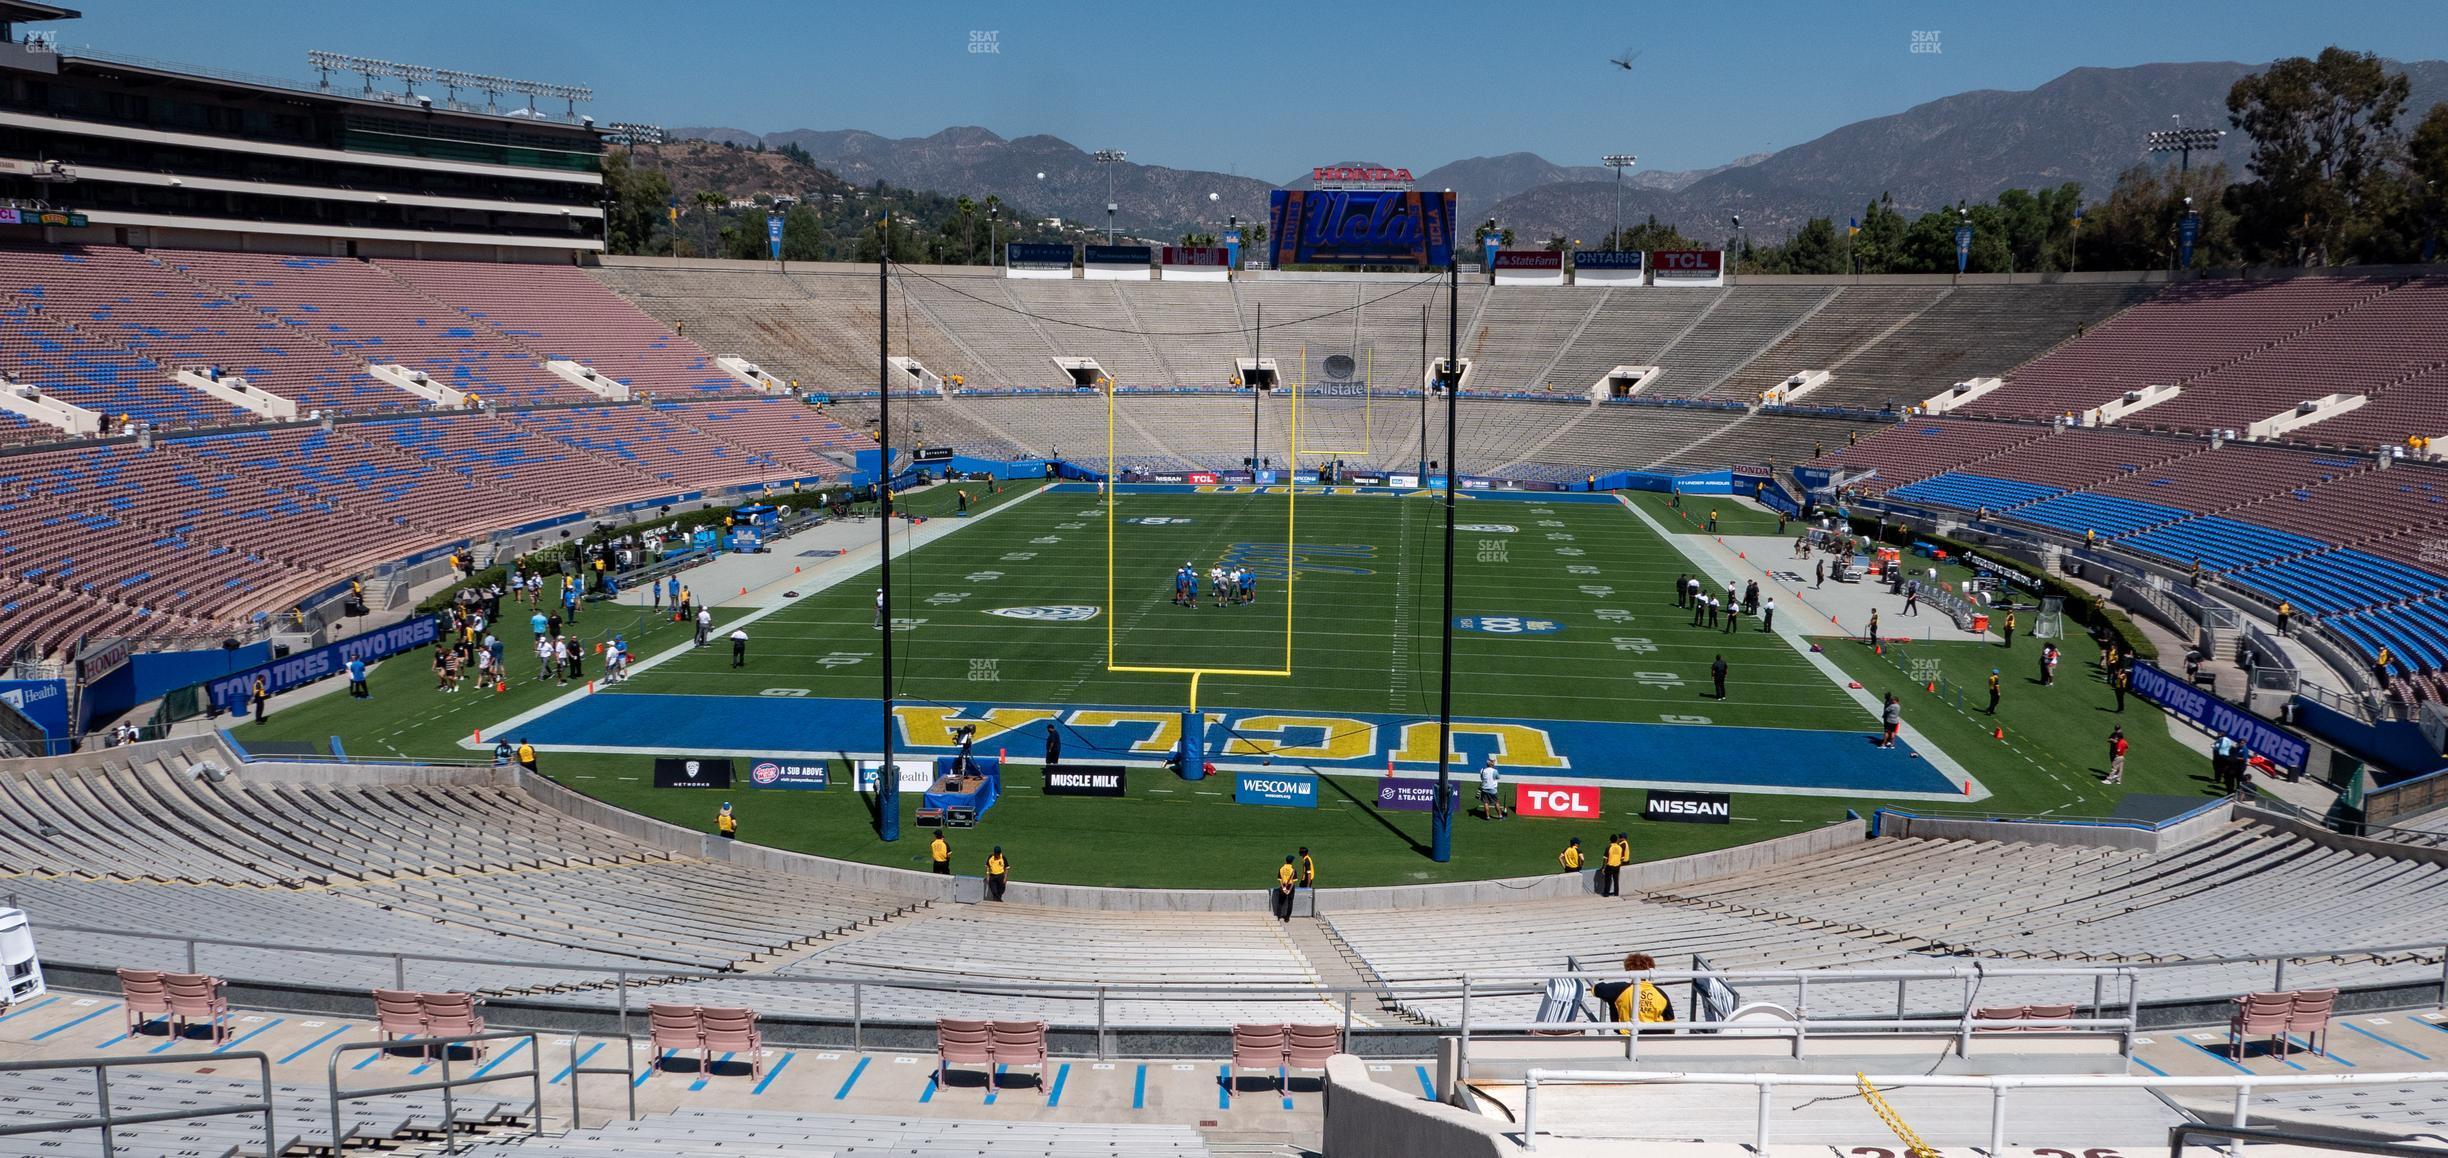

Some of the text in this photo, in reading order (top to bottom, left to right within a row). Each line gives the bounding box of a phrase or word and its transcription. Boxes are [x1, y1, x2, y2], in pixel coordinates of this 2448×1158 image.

[1313, 167, 1416, 182] HONDA
[1665, 253, 1709, 268] TCL
[1313, 382, 1365, 396] Allstate
[1733, 465, 1770, 476] HONDA
[1193, 475, 1214, 483] TCL
[387, 618, 434, 650] TIRES
[85, 644, 128, 680] HONDA
[273, 650, 329, 687] TIRES
[24, 684, 58, 704] Health
[2132, 665, 2207, 718] TOYO TIRES
[2212, 705, 2305, 767] TOYO TIRES
[780, 766, 786, 775] A
[787, 766, 801, 775] SUB
[1050, 774, 1119, 789] MUSCLE MILK
[1243, 779, 1298, 794] WESCOM
[1527, 790, 1589, 812] TCL
[1649, 799, 1728, 816] NISSAN
[1640, 991, 1654, 1001] SC
